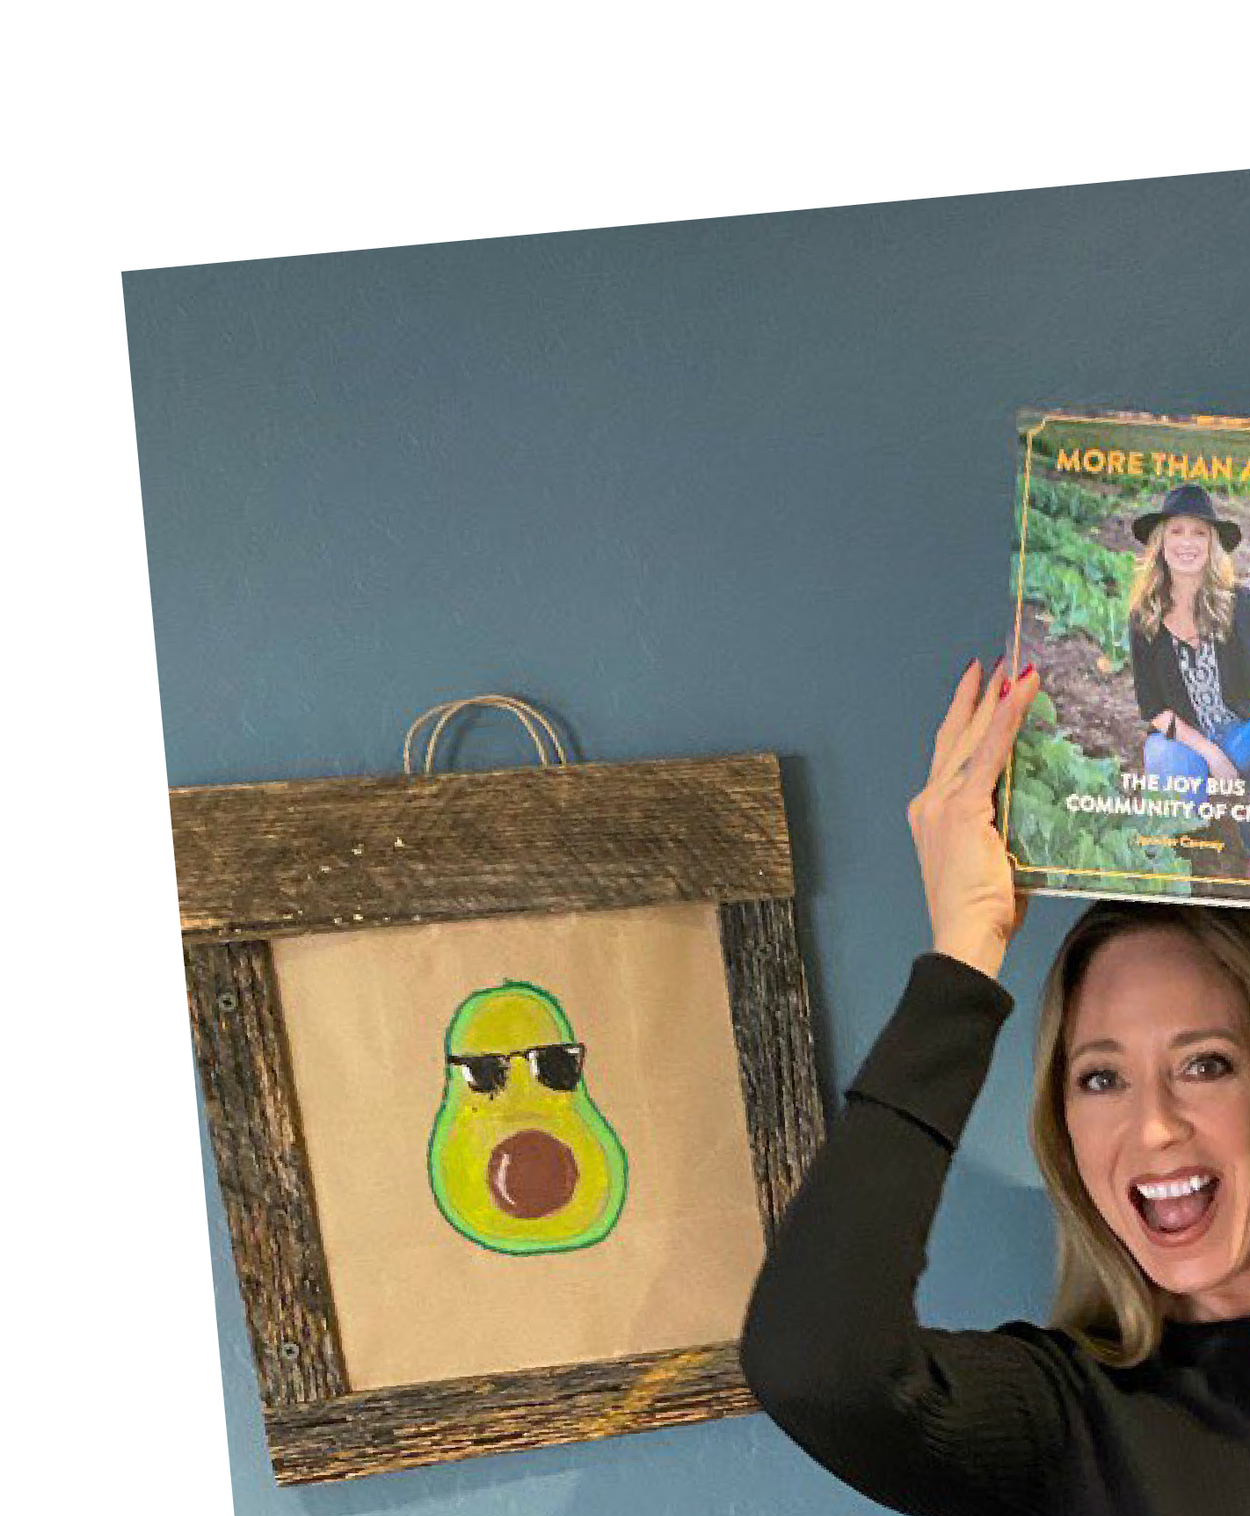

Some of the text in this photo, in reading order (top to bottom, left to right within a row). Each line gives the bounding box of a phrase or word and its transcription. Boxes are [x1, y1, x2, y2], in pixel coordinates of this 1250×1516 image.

[1056, 448, 1145, 474] MORE
[1151, 451, 1234, 480] THAN
[1121, 773, 1246, 797] THE JOY BUS
[1066, 794, 1195, 819] COMMUNITY
[1198, 802, 1228, 820] OF
